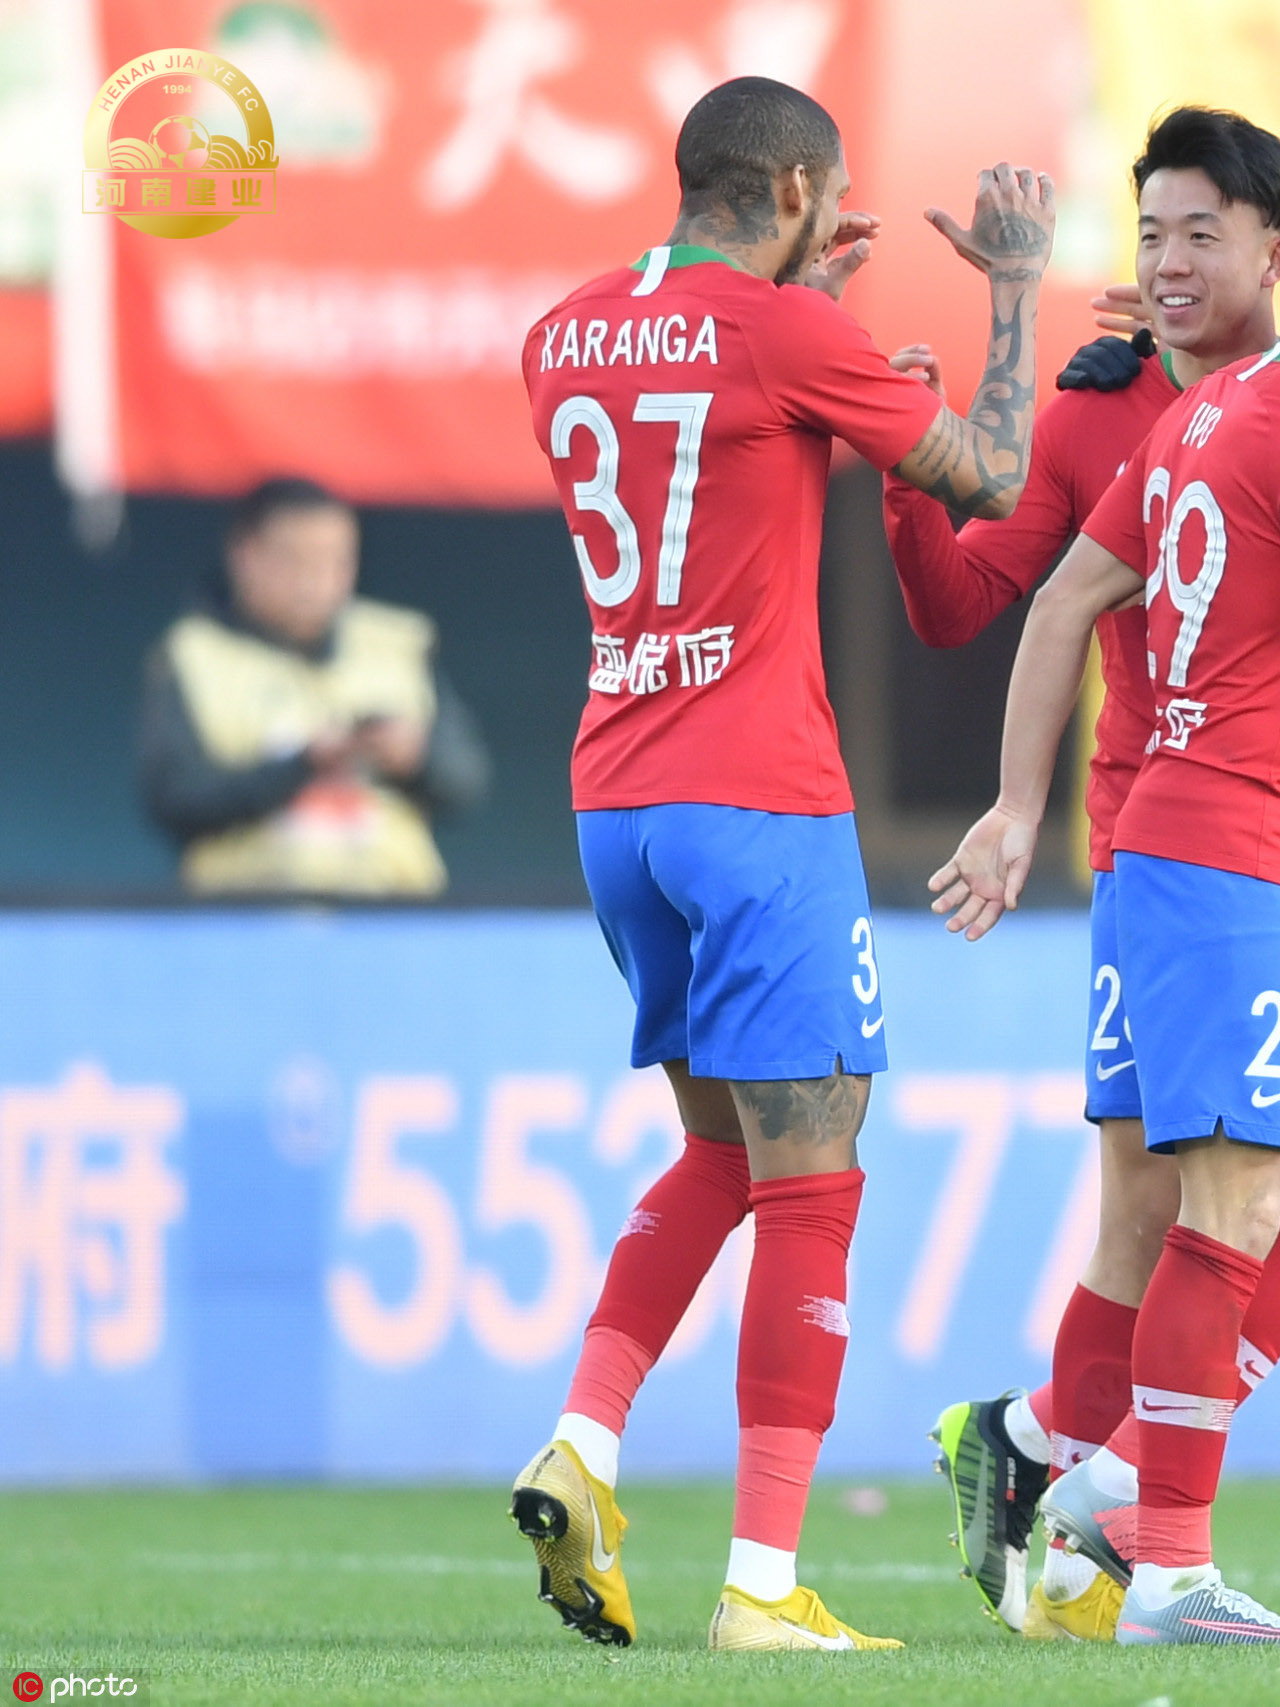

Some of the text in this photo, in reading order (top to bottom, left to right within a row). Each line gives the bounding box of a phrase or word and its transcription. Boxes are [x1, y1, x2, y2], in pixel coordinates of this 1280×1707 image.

[540, 314, 718, 373] KARANGA
[550, 392, 714, 607] 37
[1143, 466, 1227, 688] 29
[588, 624, 735, 695] 盛悦府
